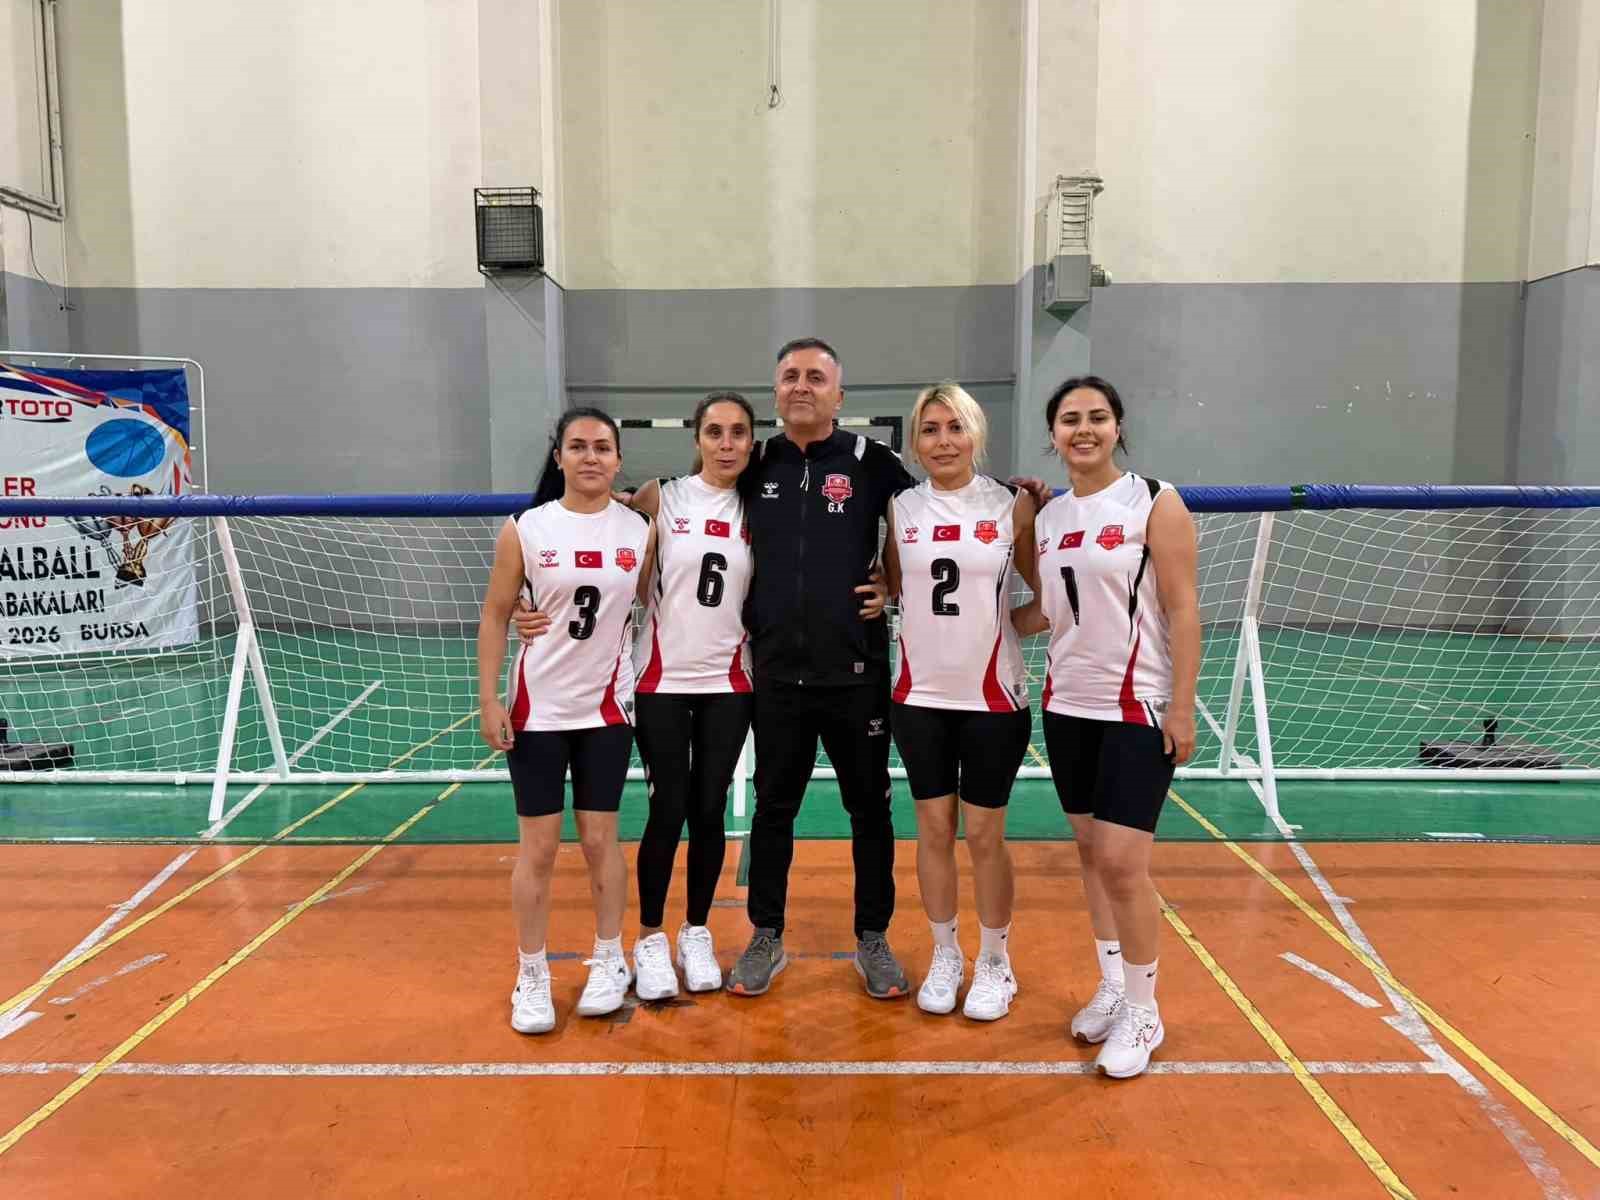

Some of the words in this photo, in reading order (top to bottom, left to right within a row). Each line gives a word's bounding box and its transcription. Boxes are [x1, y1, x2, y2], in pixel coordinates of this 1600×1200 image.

[0, 399, 73, 417] TOTO
[0, 477, 36, 497] ER
[828, 502, 844, 513] G.K
[697, 552, 728, 608] 6
[931, 558, 960, 616] 2
[1060, 566, 1080, 626] 1
[8, 625, 61, 645] 2026
[80, 621, 150, 641] BURSA
[568, 585, 601, 641] 3
